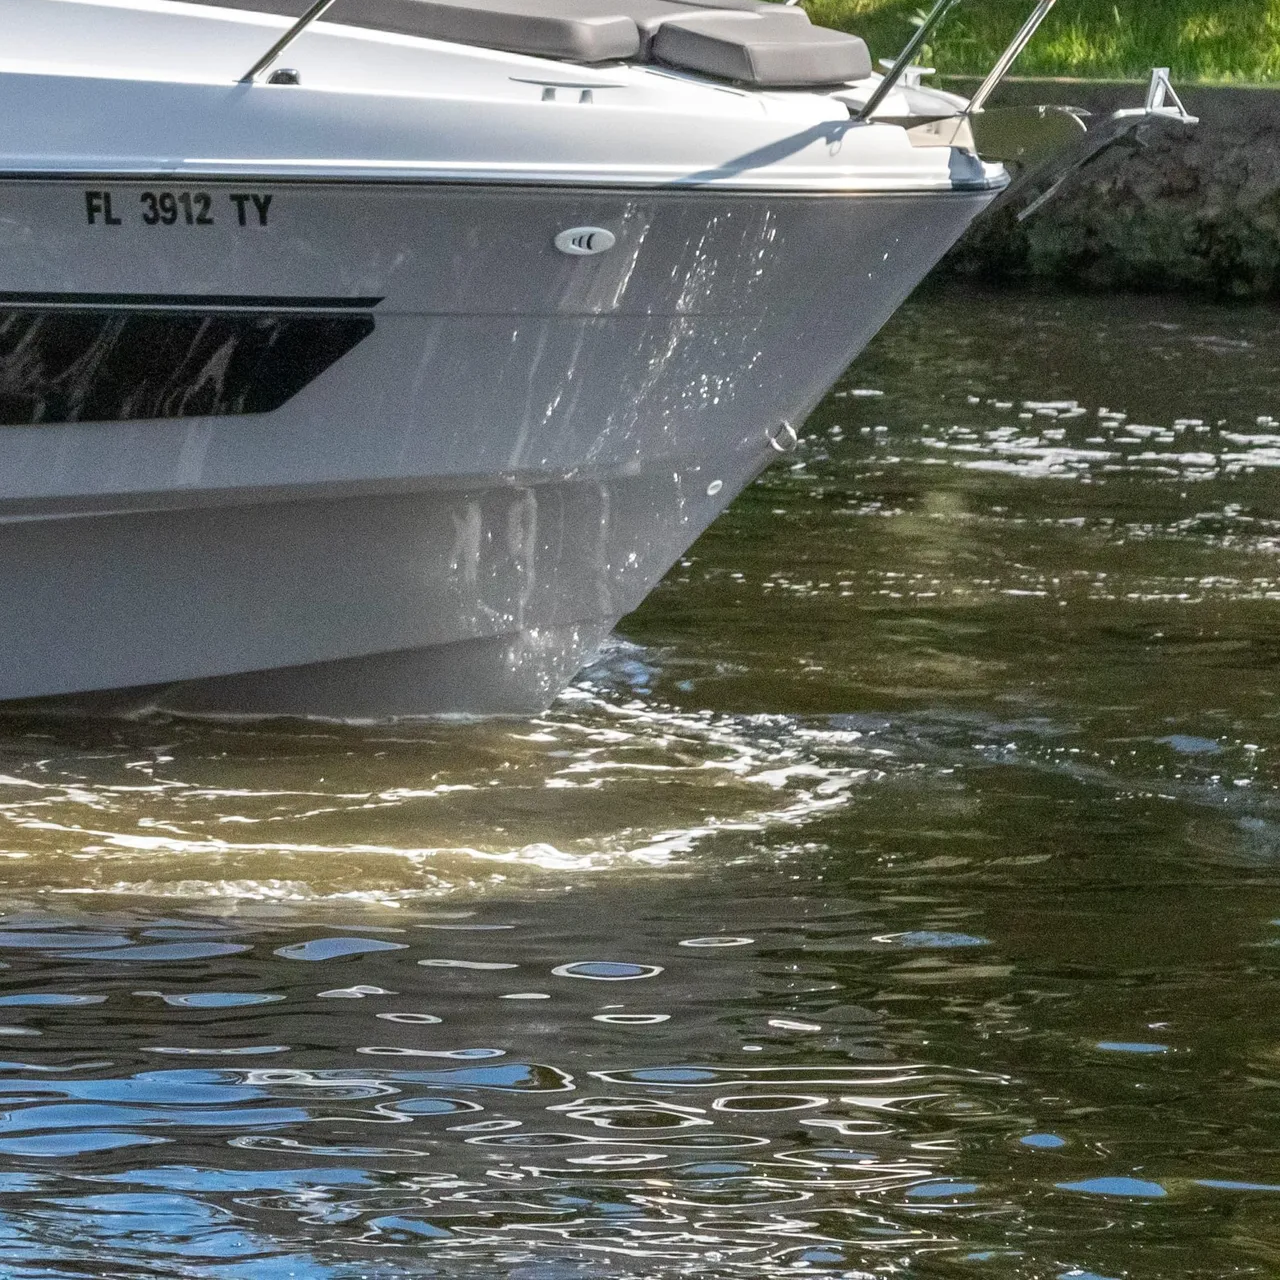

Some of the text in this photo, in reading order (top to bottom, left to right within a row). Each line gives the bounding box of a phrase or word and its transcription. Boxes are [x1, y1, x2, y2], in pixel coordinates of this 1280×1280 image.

[84, 190, 273, 226] FL 3912 TY
